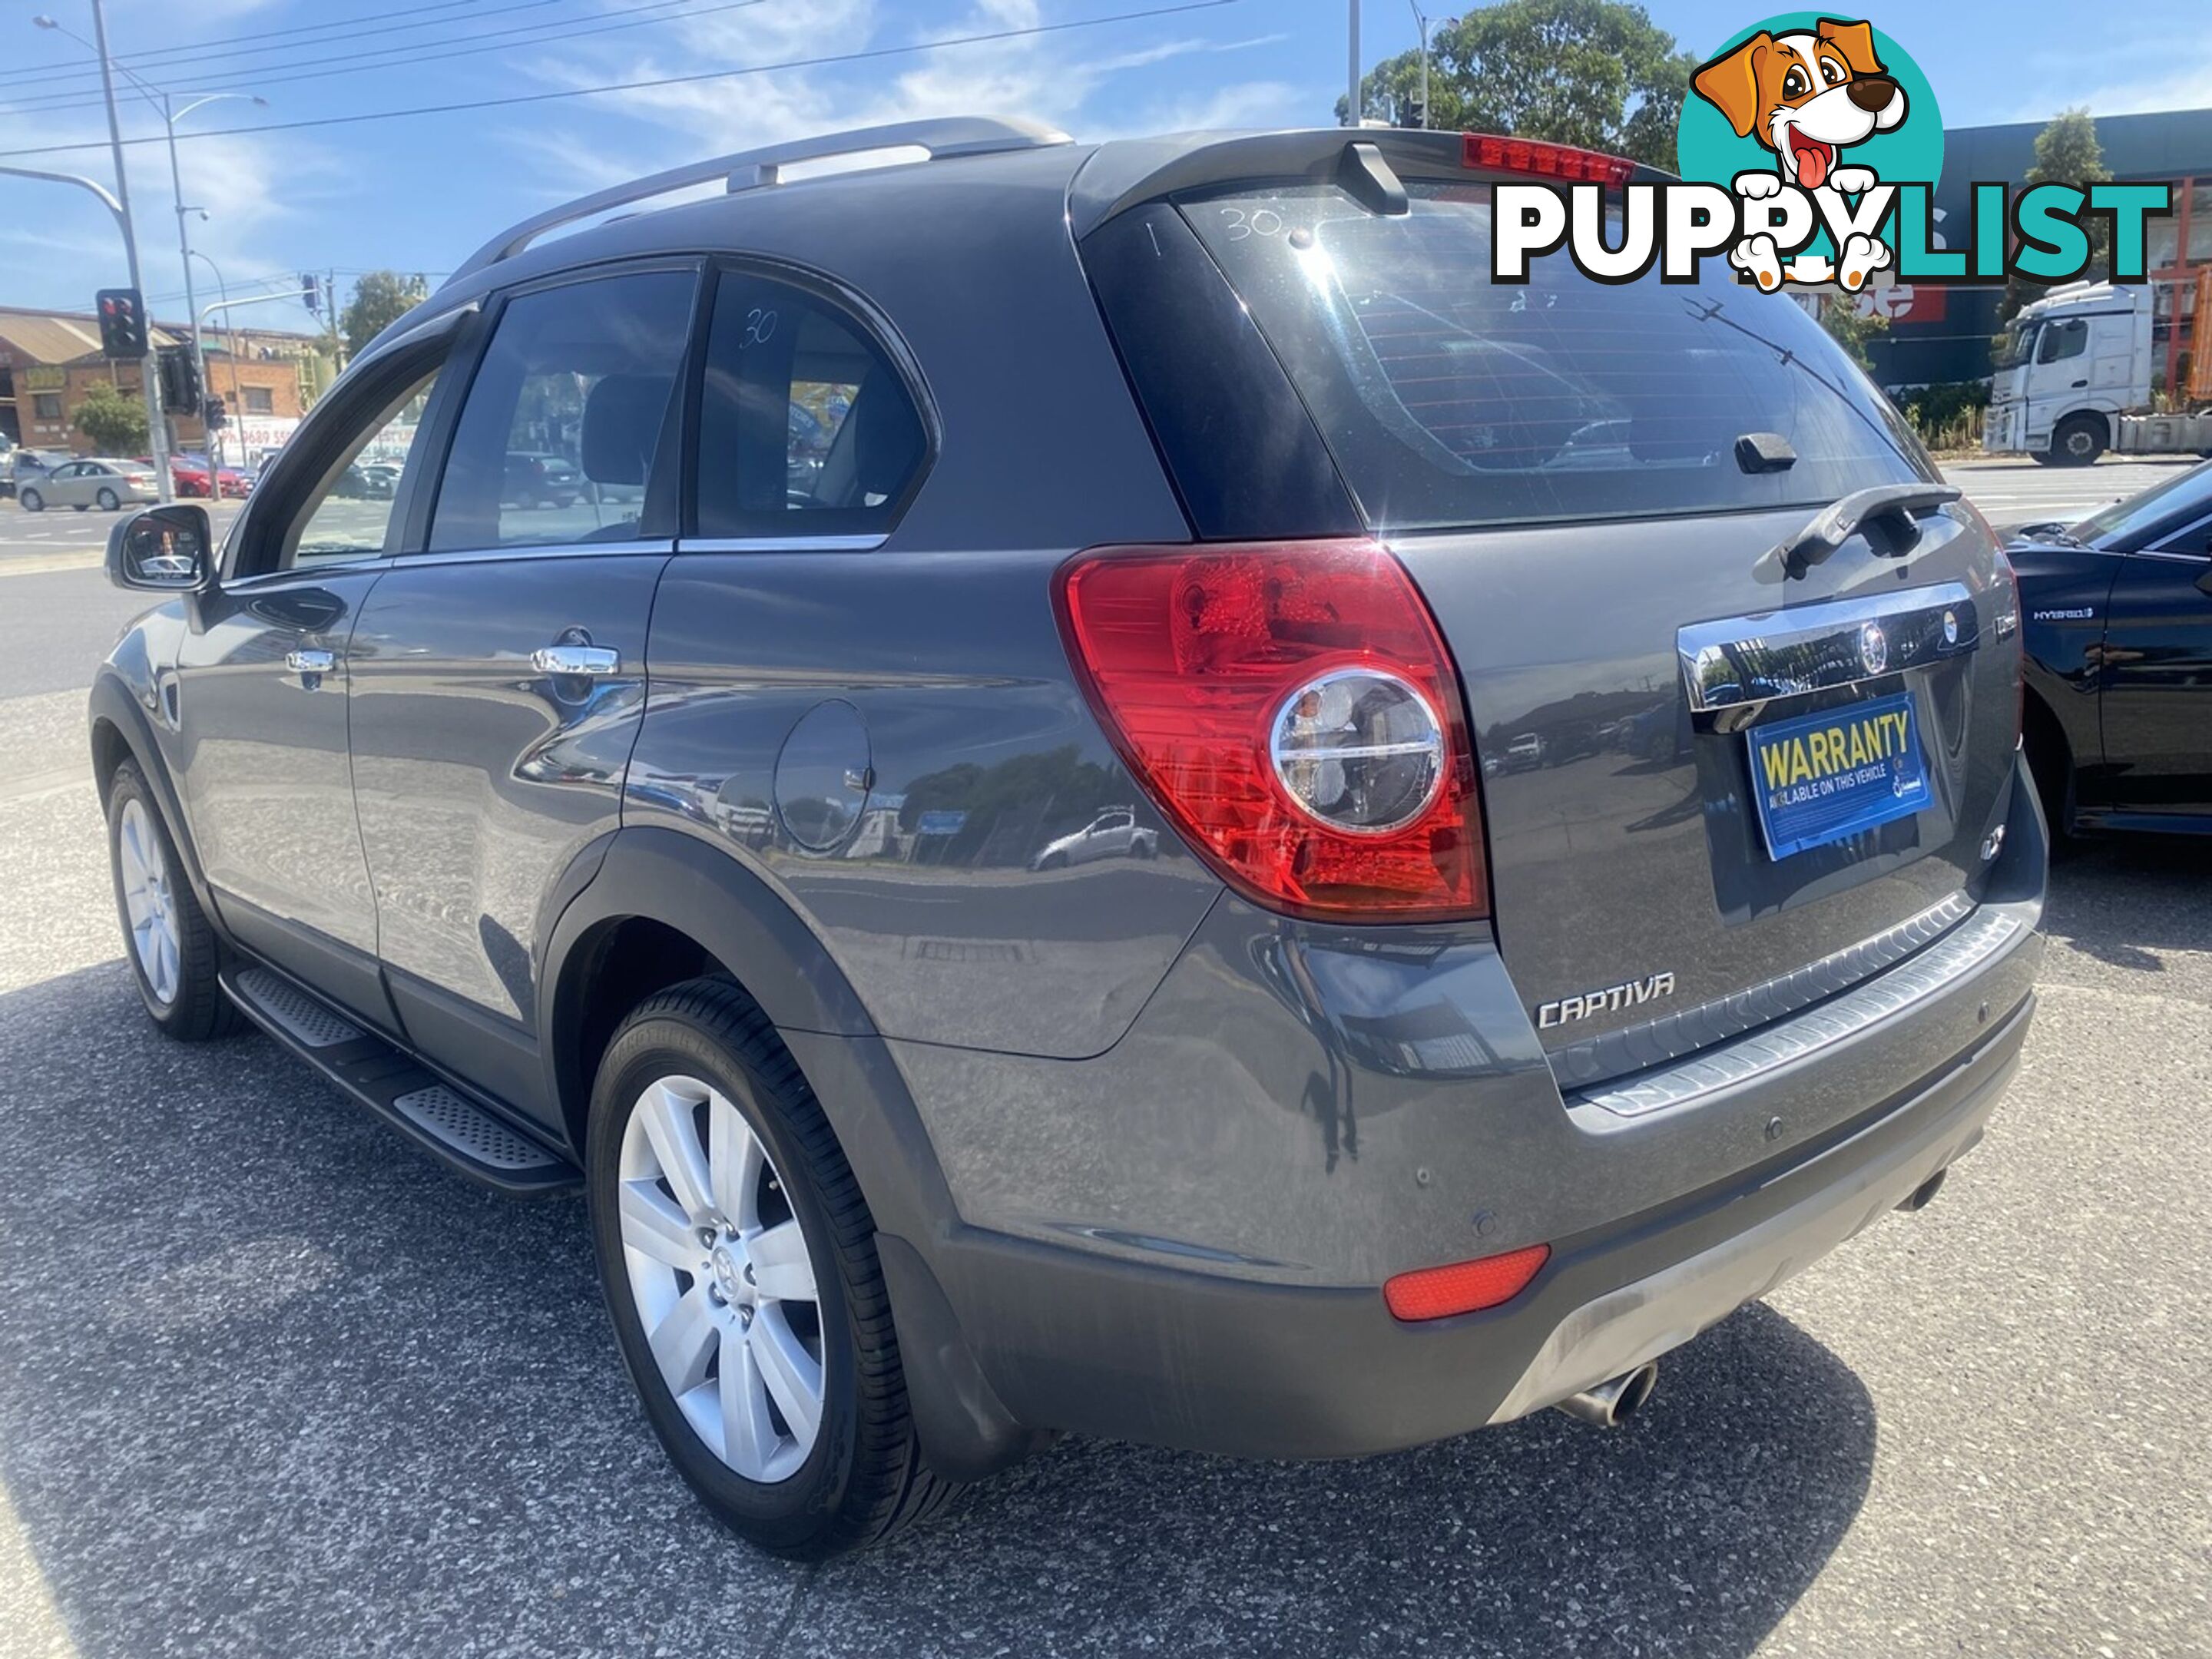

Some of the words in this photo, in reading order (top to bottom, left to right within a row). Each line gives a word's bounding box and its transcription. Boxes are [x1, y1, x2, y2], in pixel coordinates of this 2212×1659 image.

[1220, 207, 1282, 241] 30
[738, 308, 777, 348] 30
[1760, 710, 1909, 791] WARRANTY
[1819, 777, 1835, 796] ON
[1834, 772, 1855, 792] THIS
[1854, 763, 1886, 786] VEHICLE
[1538, 971, 1675, 1029] CAPTIVA
